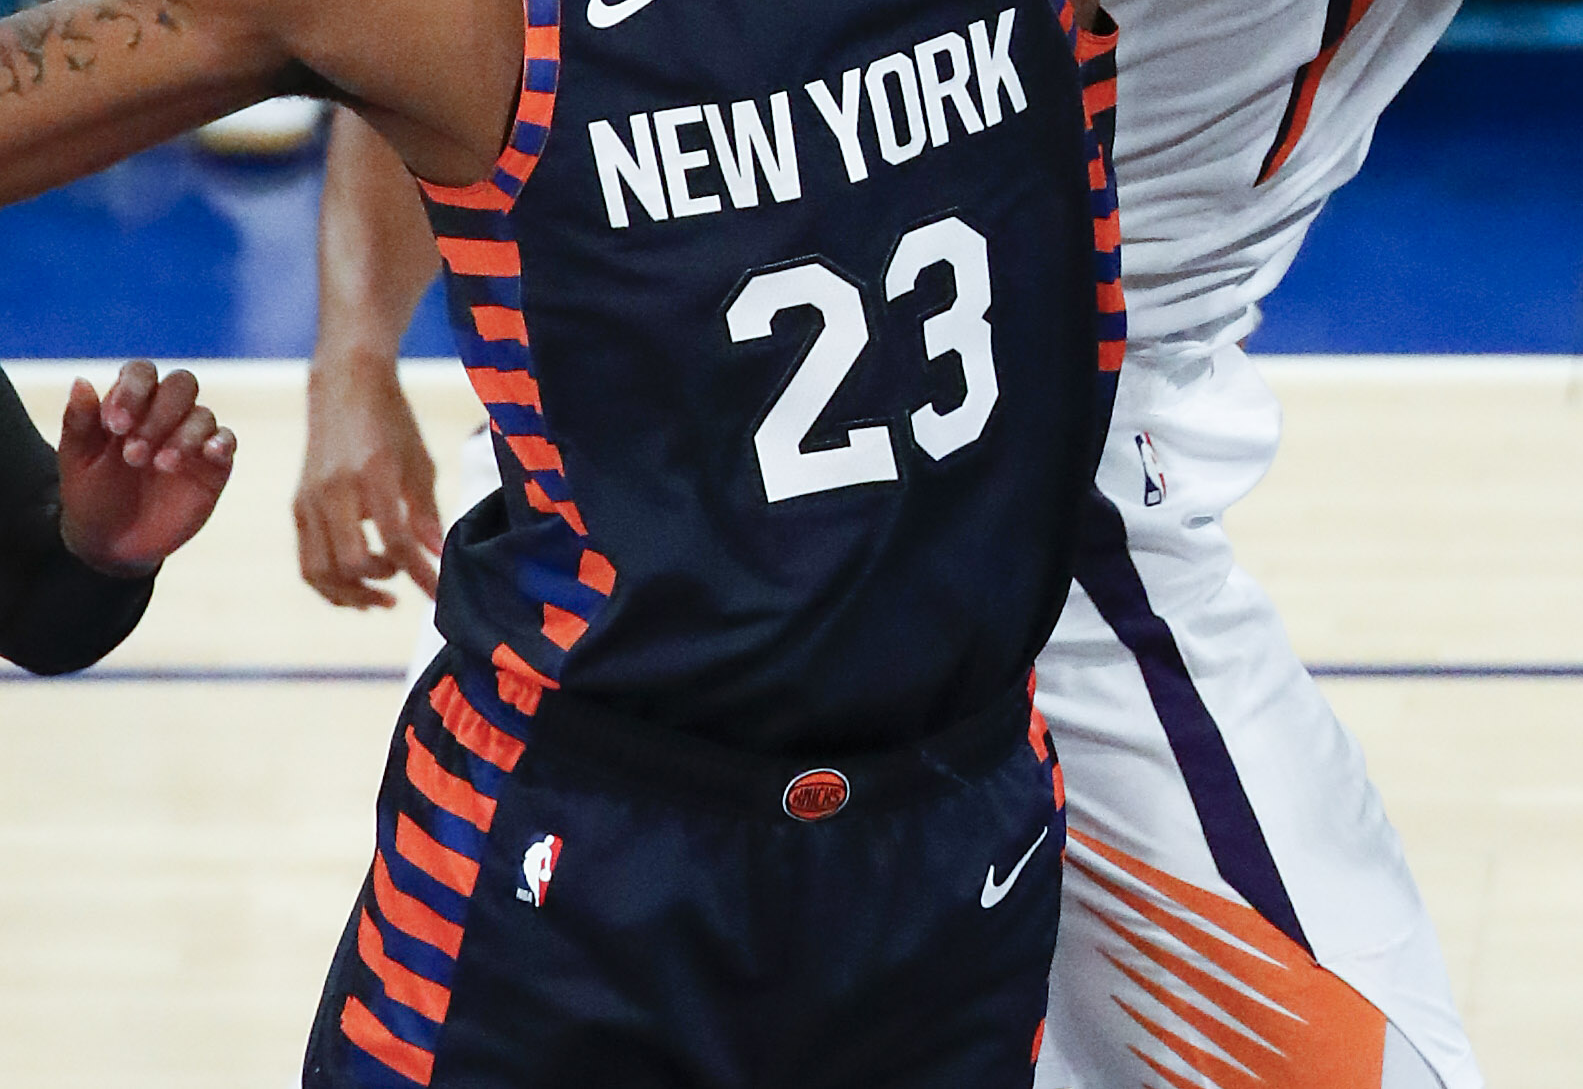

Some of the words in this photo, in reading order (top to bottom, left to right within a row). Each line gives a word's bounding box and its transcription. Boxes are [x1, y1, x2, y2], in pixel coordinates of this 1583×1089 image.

[588, 90, 802, 228] NEW
[804, 7, 1028, 184] YORK
[725, 215, 999, 504] 23
